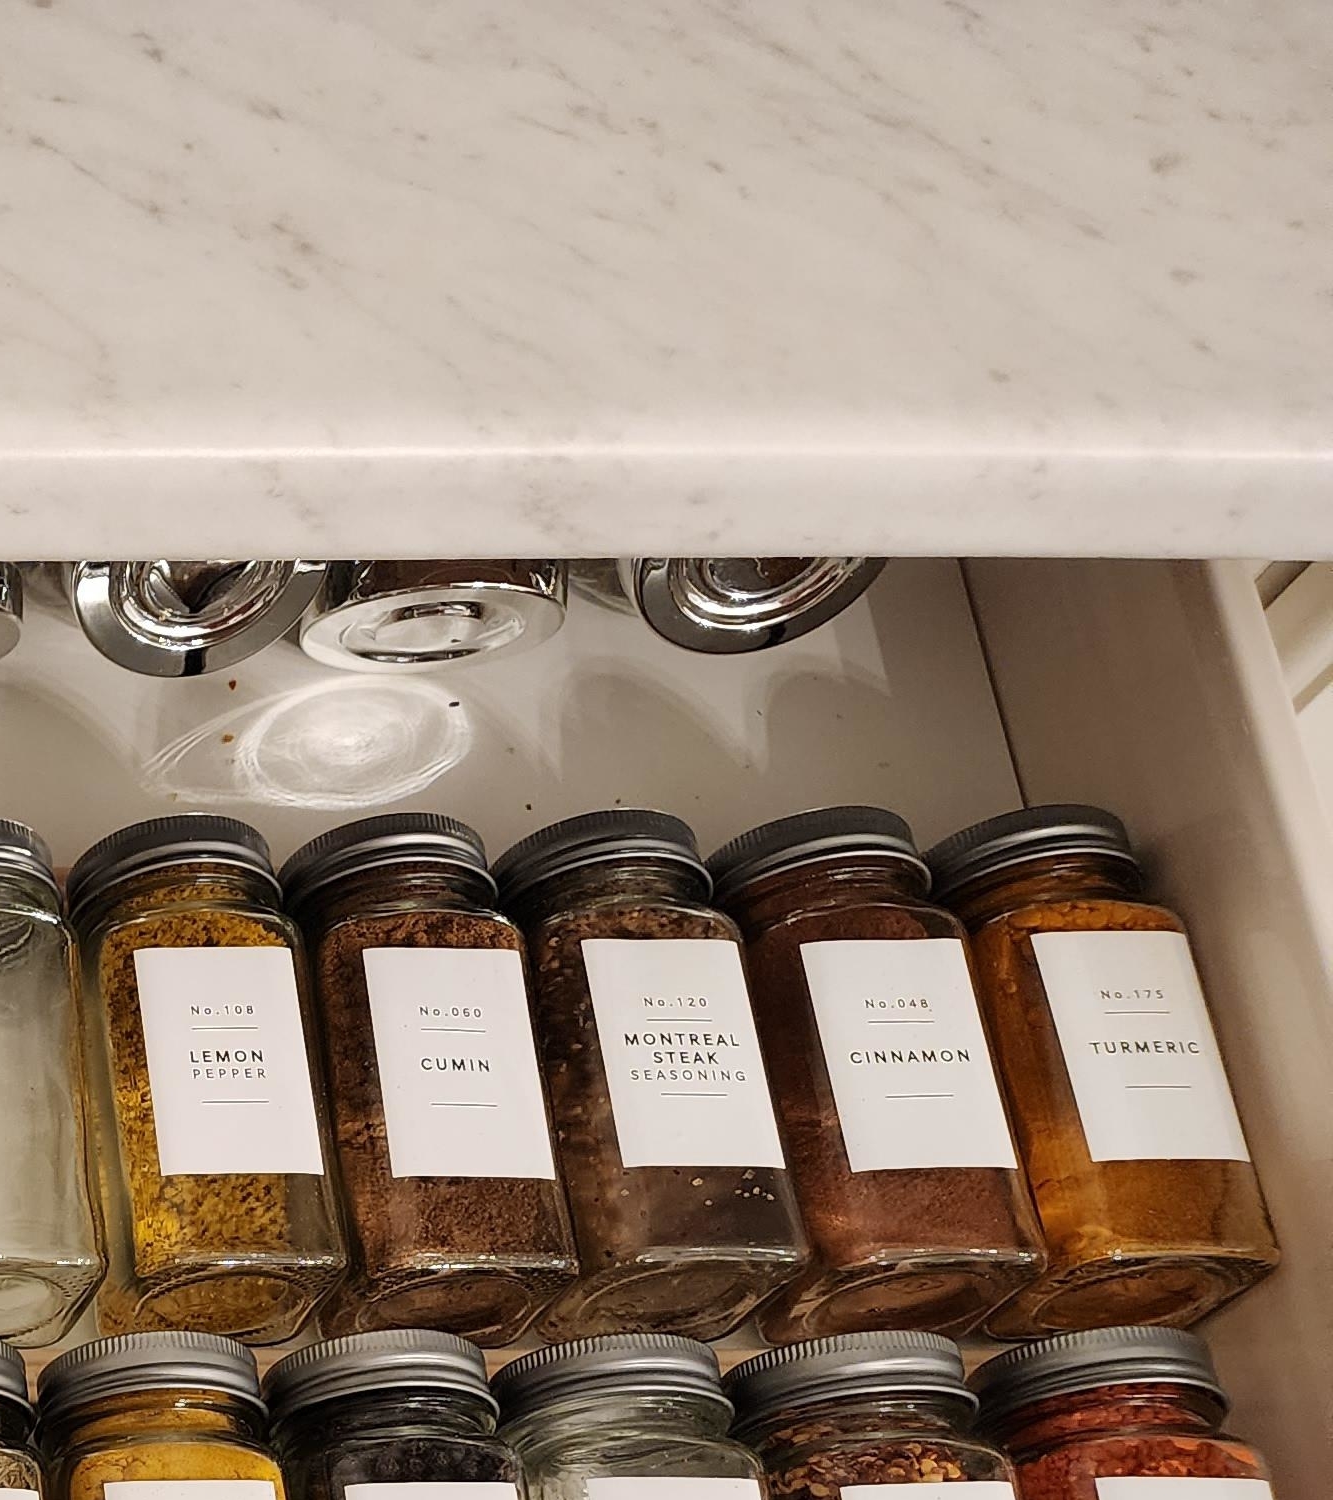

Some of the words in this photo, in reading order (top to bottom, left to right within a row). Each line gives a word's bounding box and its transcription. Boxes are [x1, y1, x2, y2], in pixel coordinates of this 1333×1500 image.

[1100, 989, 1164, 1000] No.175
[643, 997, 707, 1008] No.120
[864, 998, 931, 1008] No.048
[190, 1005, 254, 1016] No.108
[419, 1006, 482, 1018] No.060
[624, 1032, 740, 1047] MONTREAL
[1088, 1040, 1200, 1055] TURMERIC
[189, 1049, 264, 1064] LEMON
[653, 1051, 719, 1065] STEAK
[850, 1049, 971, 1064] CINNAMON
[420, 1057, 490, 1073] CUMIN
[192, 1067, 266, 1080] PEPPER
[630, 1069, 746, 1082] SEASONING
